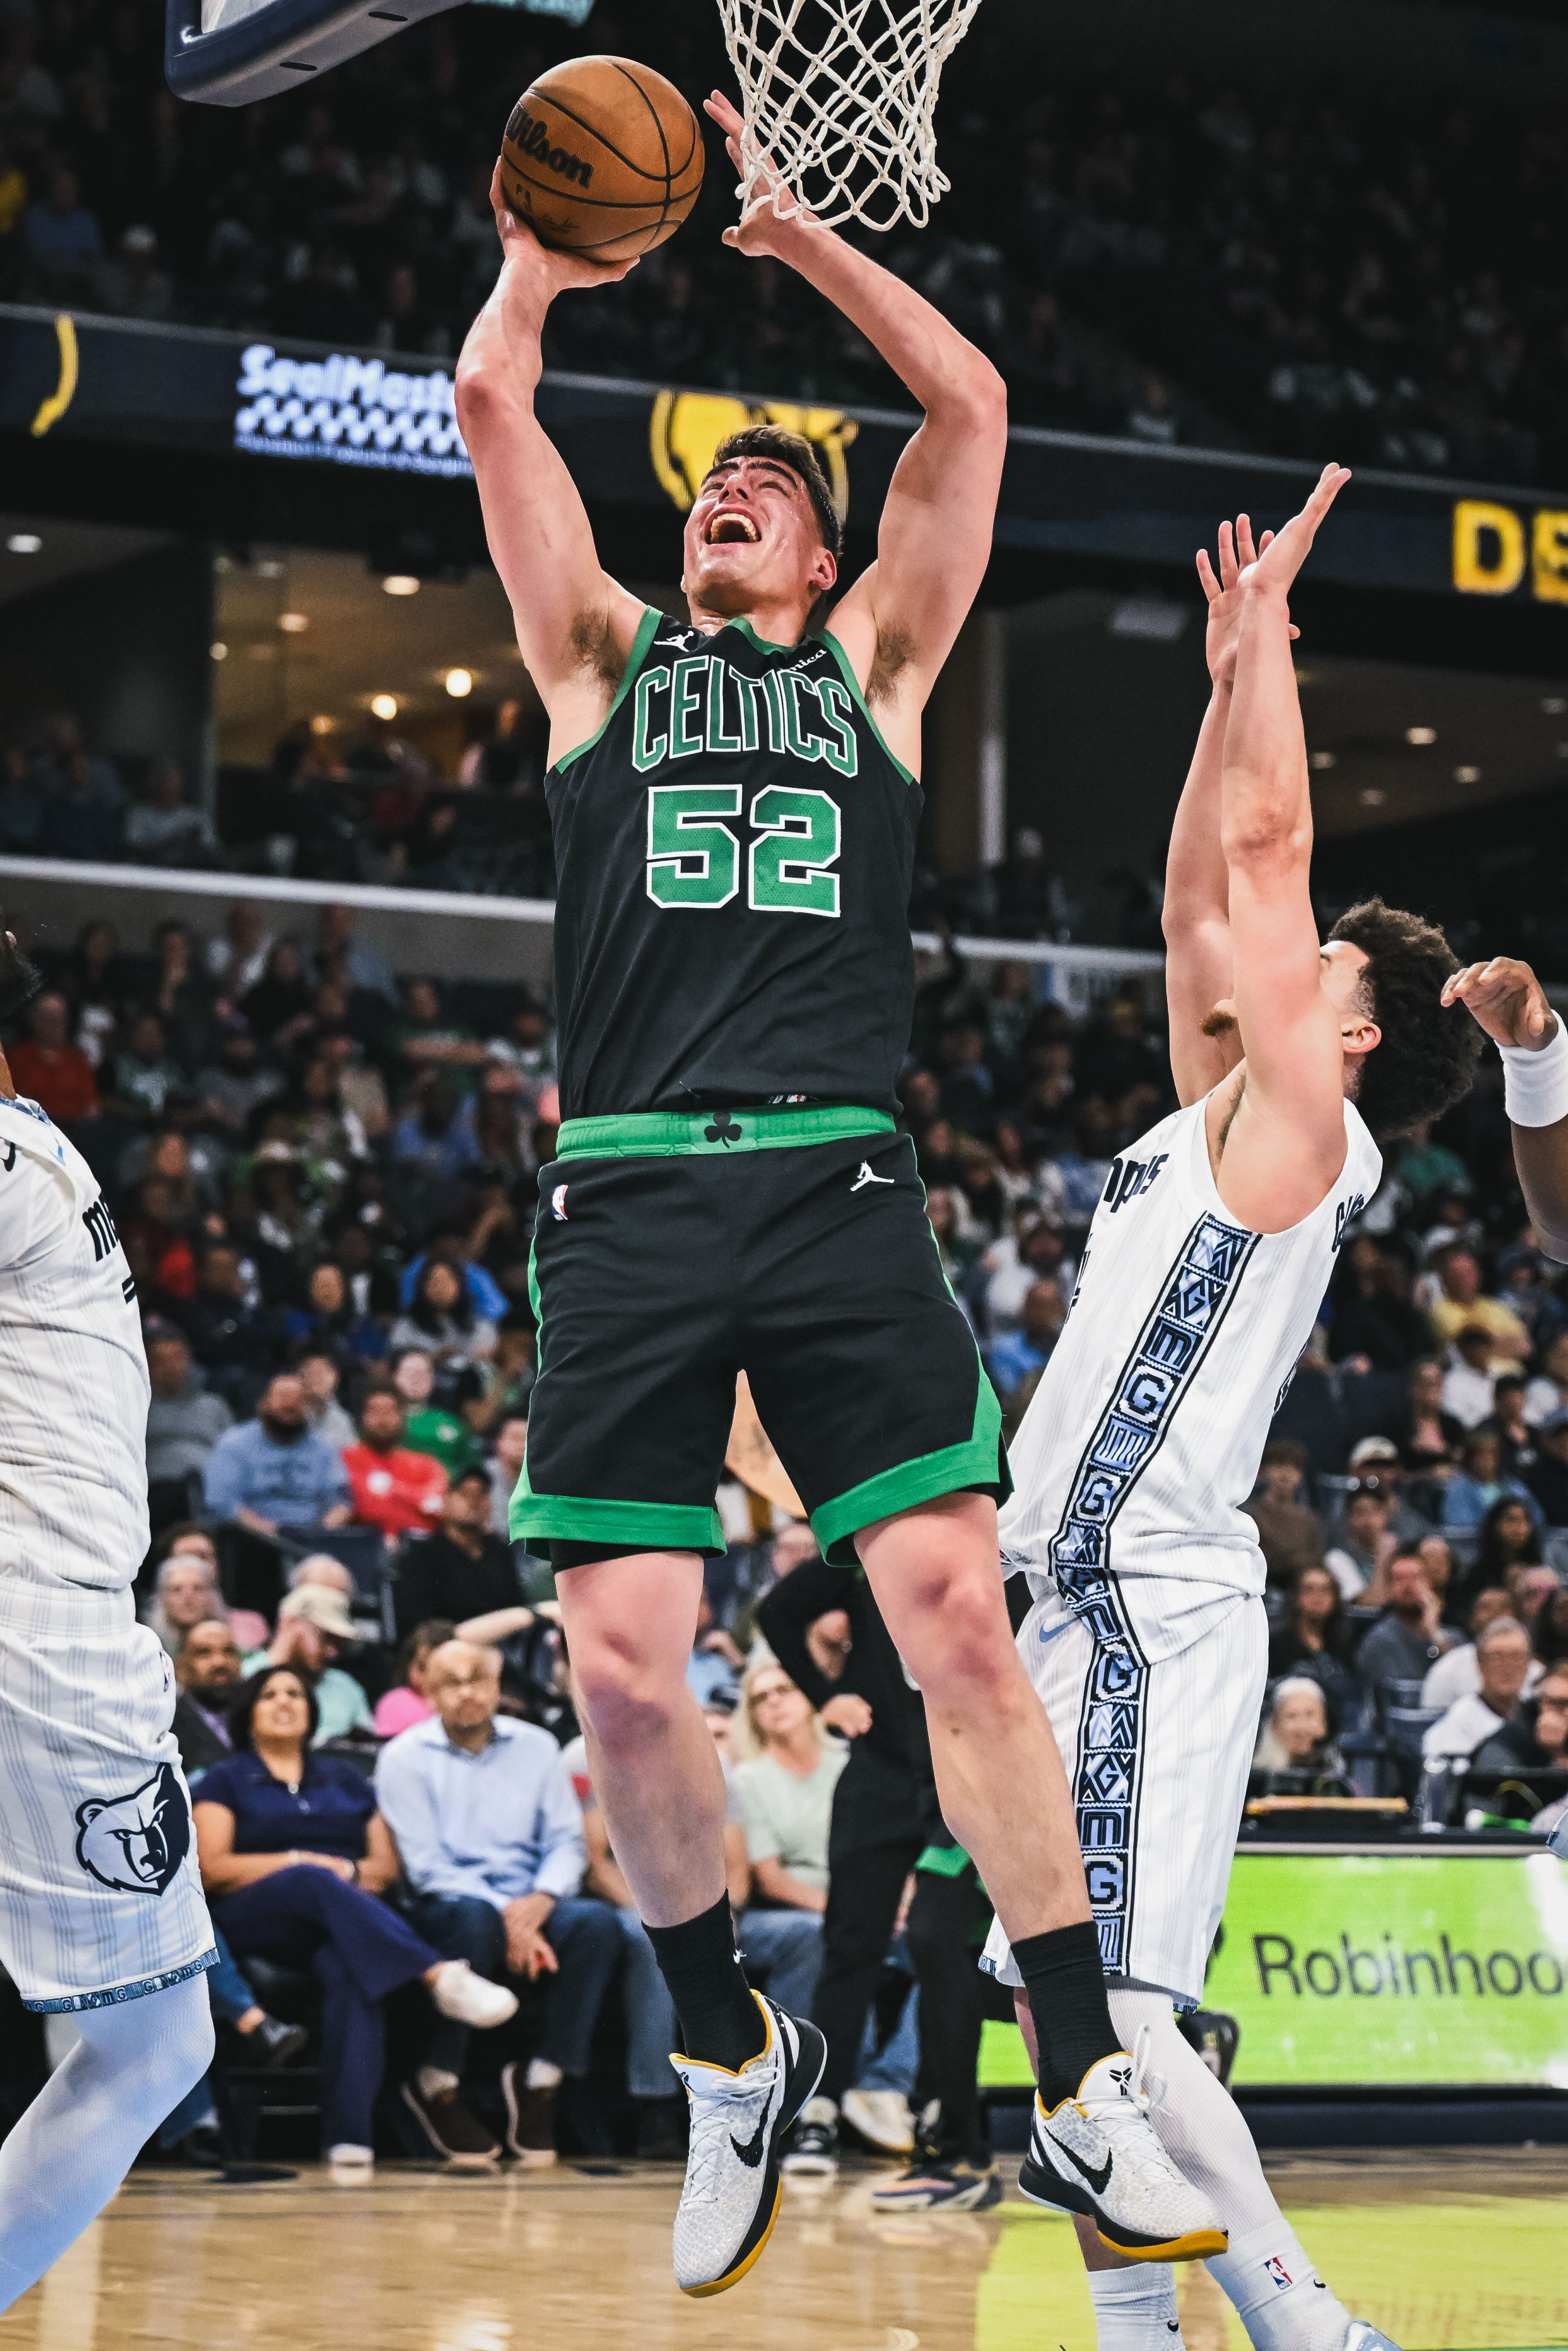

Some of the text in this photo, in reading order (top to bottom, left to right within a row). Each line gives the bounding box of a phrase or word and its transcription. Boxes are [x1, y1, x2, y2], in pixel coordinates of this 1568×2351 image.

[789, 649, 827, 671] mica
[632, 655, 858, 777] CELTICS
[647, 784, 841, 918] 52
[1253, 1933, 1568, 1996] Robinhoo
